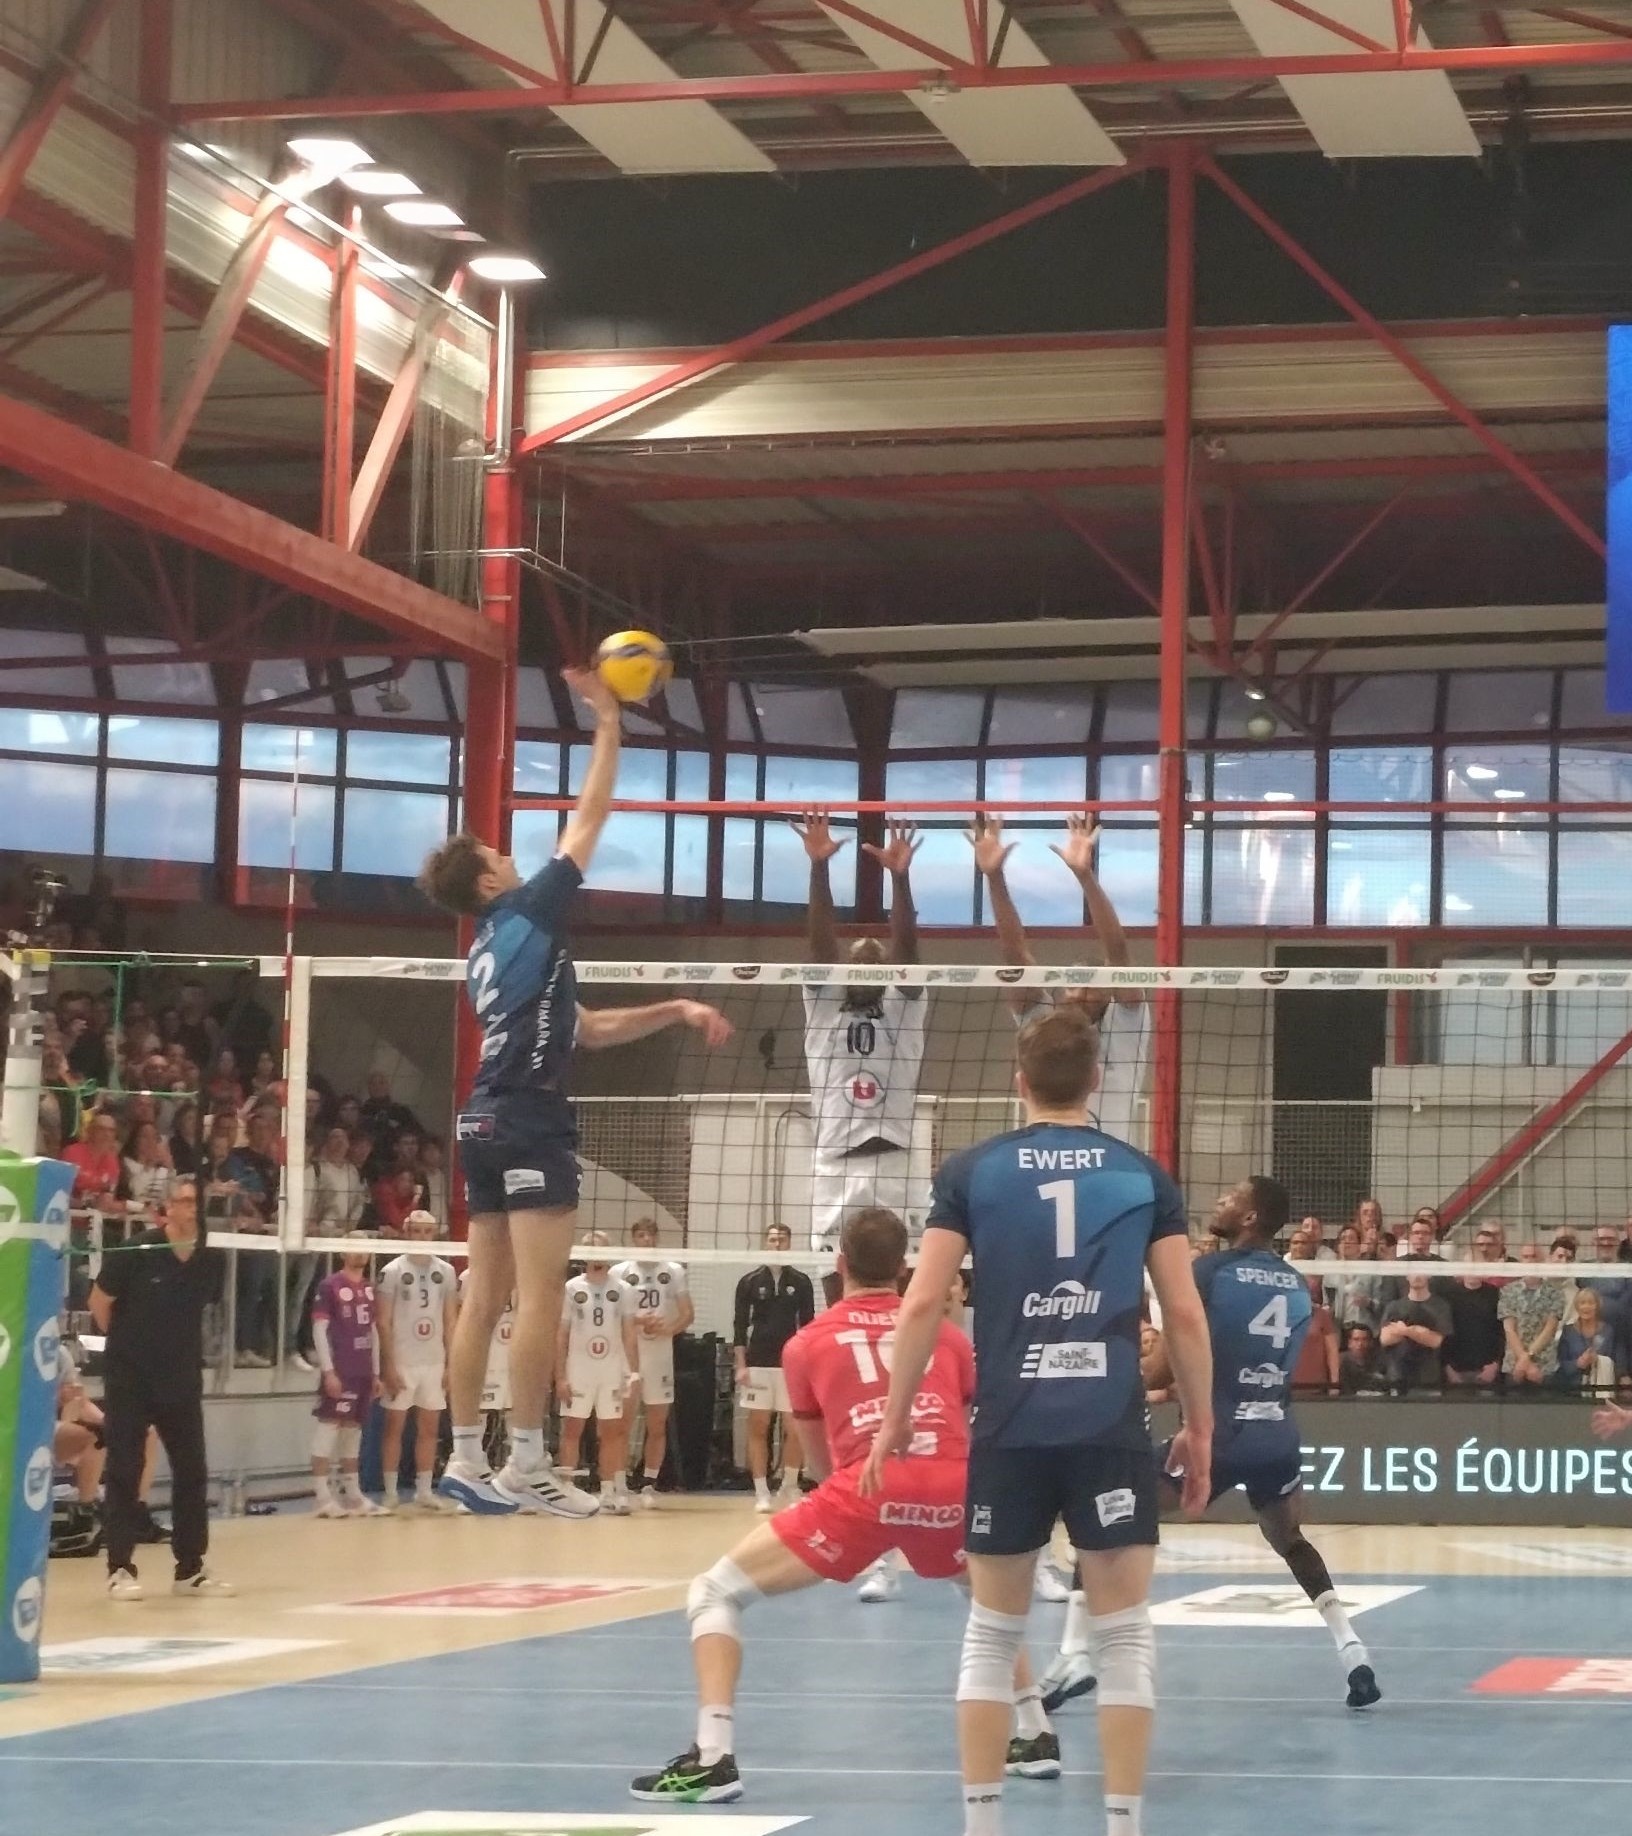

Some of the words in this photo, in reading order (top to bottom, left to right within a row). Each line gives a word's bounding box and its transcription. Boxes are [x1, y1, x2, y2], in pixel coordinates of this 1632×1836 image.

[471, 952, 498, 1014] 2
[585, 966, 631, 978] FRUIDIS
[847, 969, 894, 981] FRUIDIS
[1111, 970, 1158, 983] FRUIDIS
[1377, 973, 1424, 985] FRUIDIS
[847, 1022, 875, 1055] 10
[1018, 1148, 1105, 1170] EWERT
[1038, 1180, 1075, 1258] 1
[1236, 1267, 1299, 1289] SPENCER
[419, 1289, 429, 1308] 3
[638, 1289, 660, 1309] 20
[1023, 1290, 1101, 1320] Cargill
[593, 1307, 604, 1326] 8
[1248, 1295, 1291, 1348] 4
[1363, 1447, 1438, 1493] LES
[879, 1502, 965, 1527] MENCO
